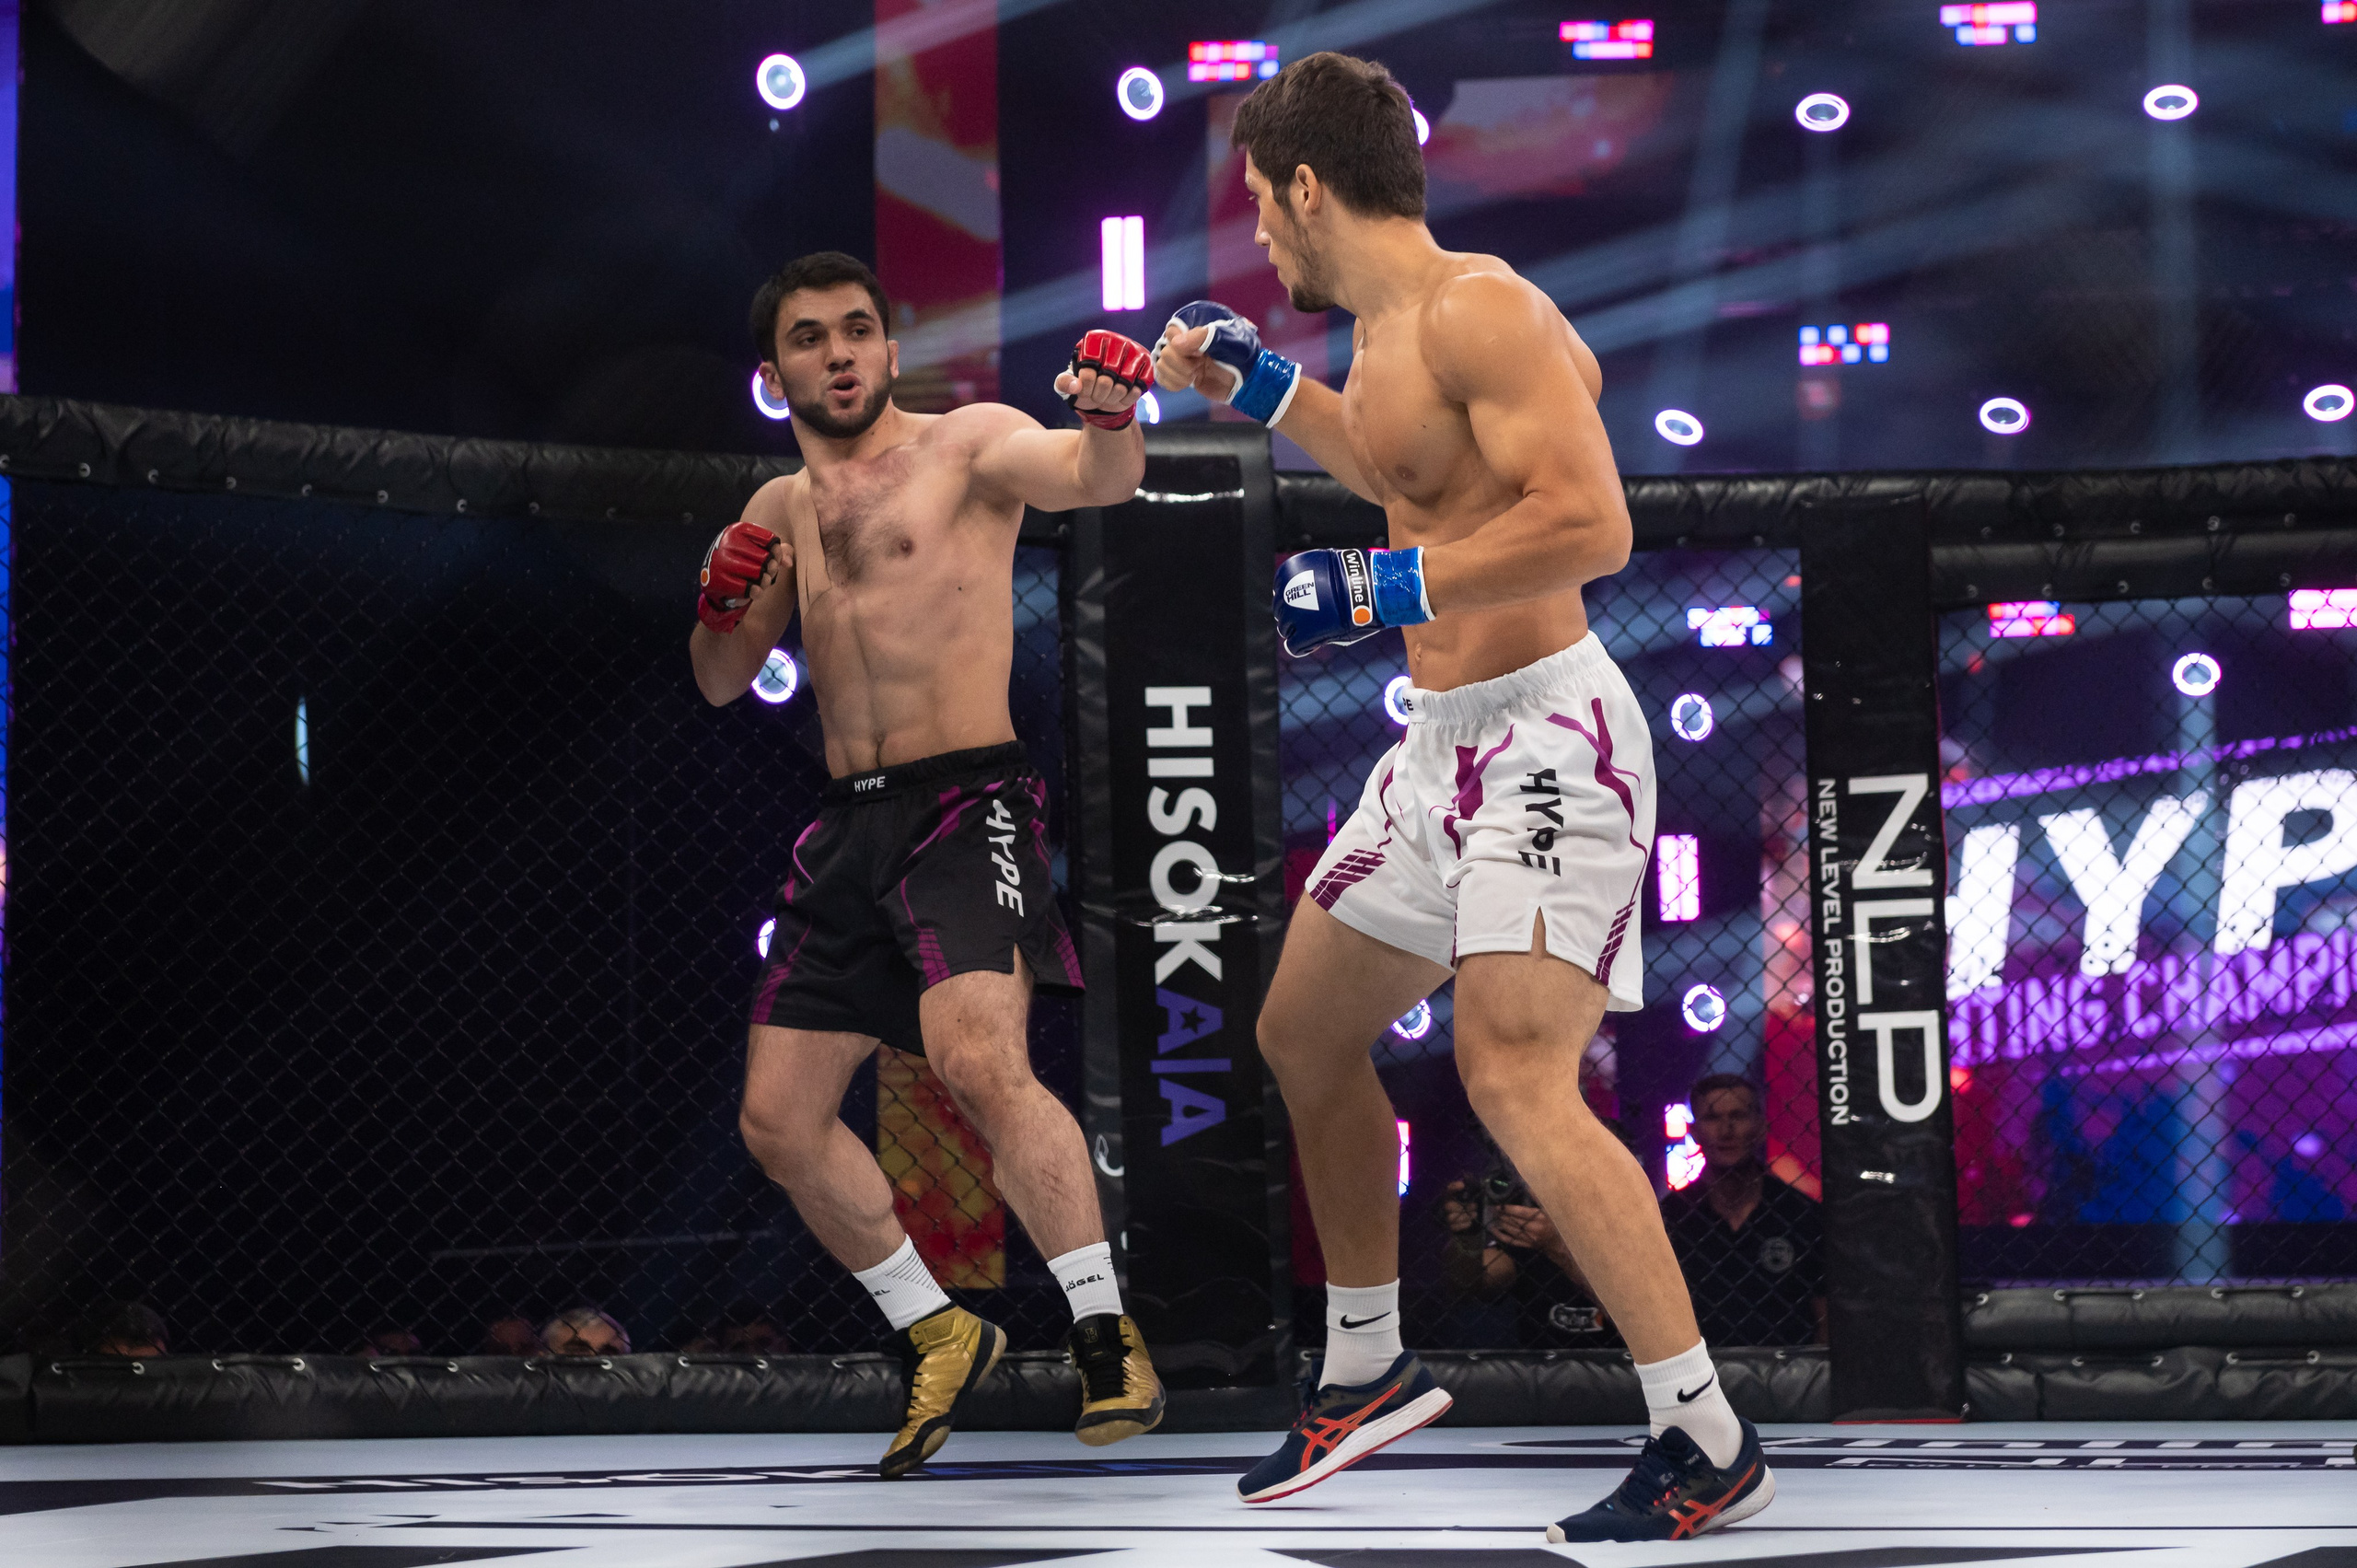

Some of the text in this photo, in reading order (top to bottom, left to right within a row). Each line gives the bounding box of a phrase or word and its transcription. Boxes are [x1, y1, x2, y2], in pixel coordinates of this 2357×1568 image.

[1284, 581, 1315, 598] GREEN
[1286, 589, 1311, 604] HILL
[1345, 552, 1365, 603] Winline
[853, 775, 887, 794] HYPE
[1517, 767, 1564, 878] HYPE
[985, 798, 1026, 918] HYPE
[1817, 778, 1851, 1126] NEW LEVEL PRODUCTION
[1848, 772, 1944, 1123] NLP
[2123, 926, 2357, 1039] CHAMPI
[1065, 1273, 1105, 1293] JÖGEL
